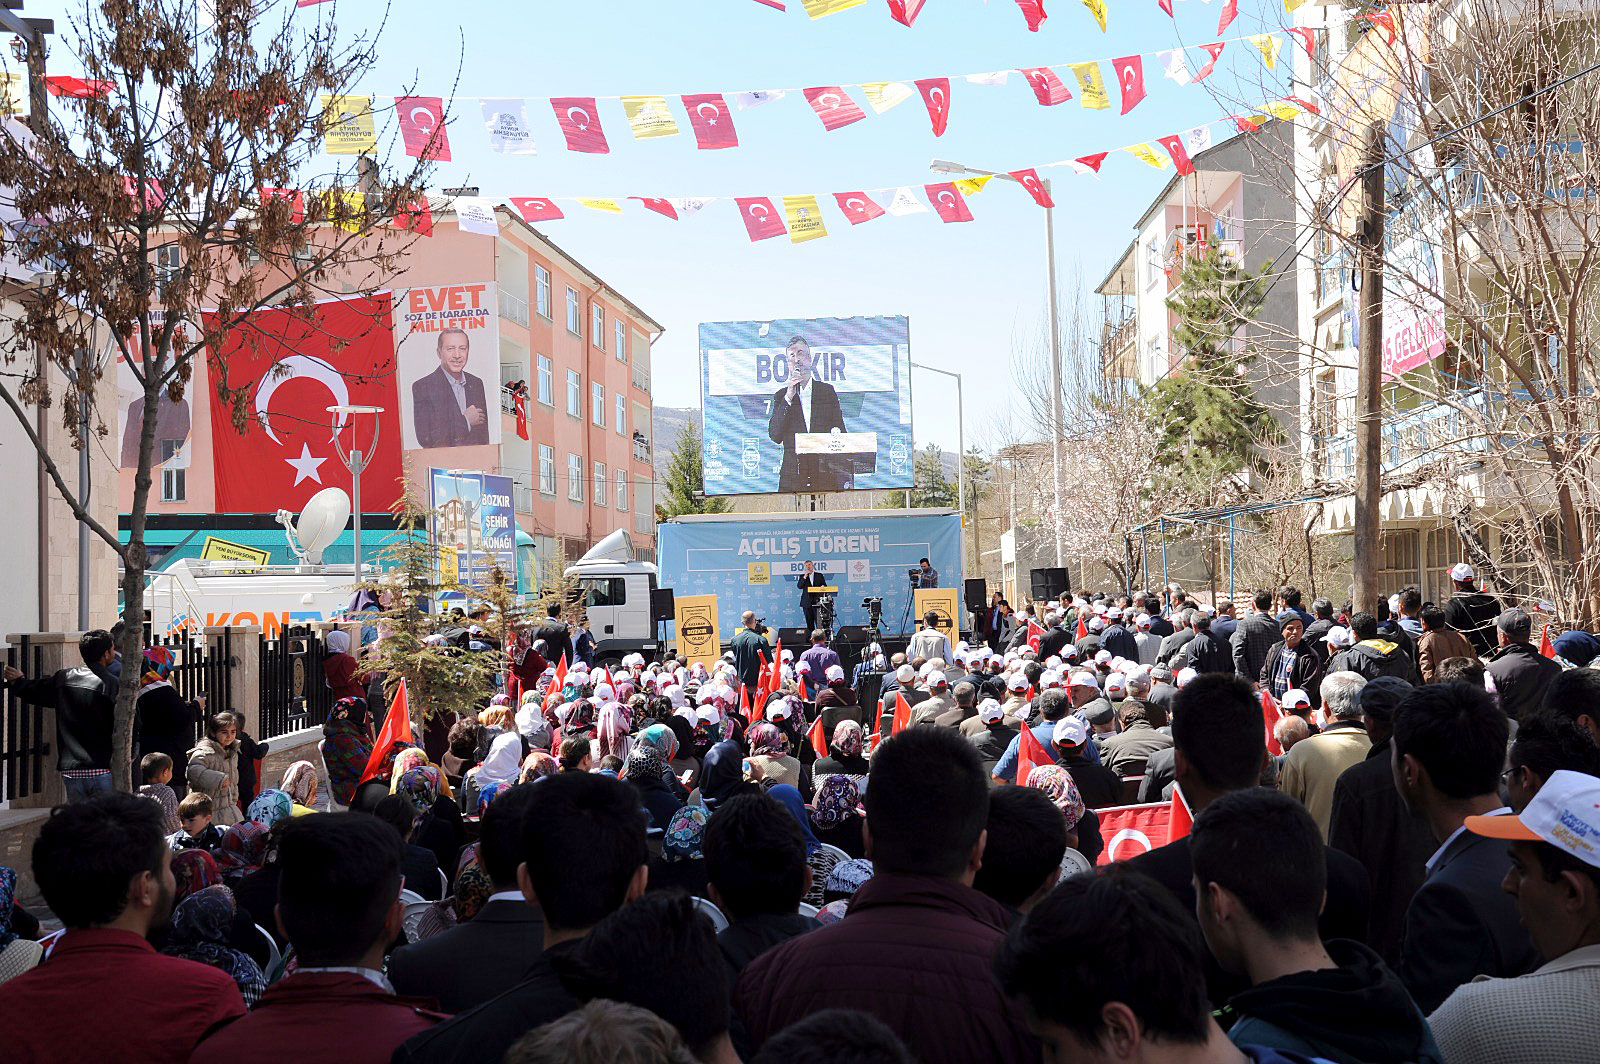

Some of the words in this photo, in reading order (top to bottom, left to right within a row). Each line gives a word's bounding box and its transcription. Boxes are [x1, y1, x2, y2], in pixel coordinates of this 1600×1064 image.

[409, 285, 486, 313] EVET
[425, 312, 438, 320] DE
[440, 309, 474, 319] KARAR
[475, 308, 490, 317] DA
[756, 352, 847, 384] BOKIR
[482, 493, 511, 508] BOZKIR
[485, 513, 509, 530] ŞEHİR
[484, 534, 512, 549] KONAĞI
[737, 537, 801, 560] AÇILIŞ
[790, 562, 828, 572] BOKIR
